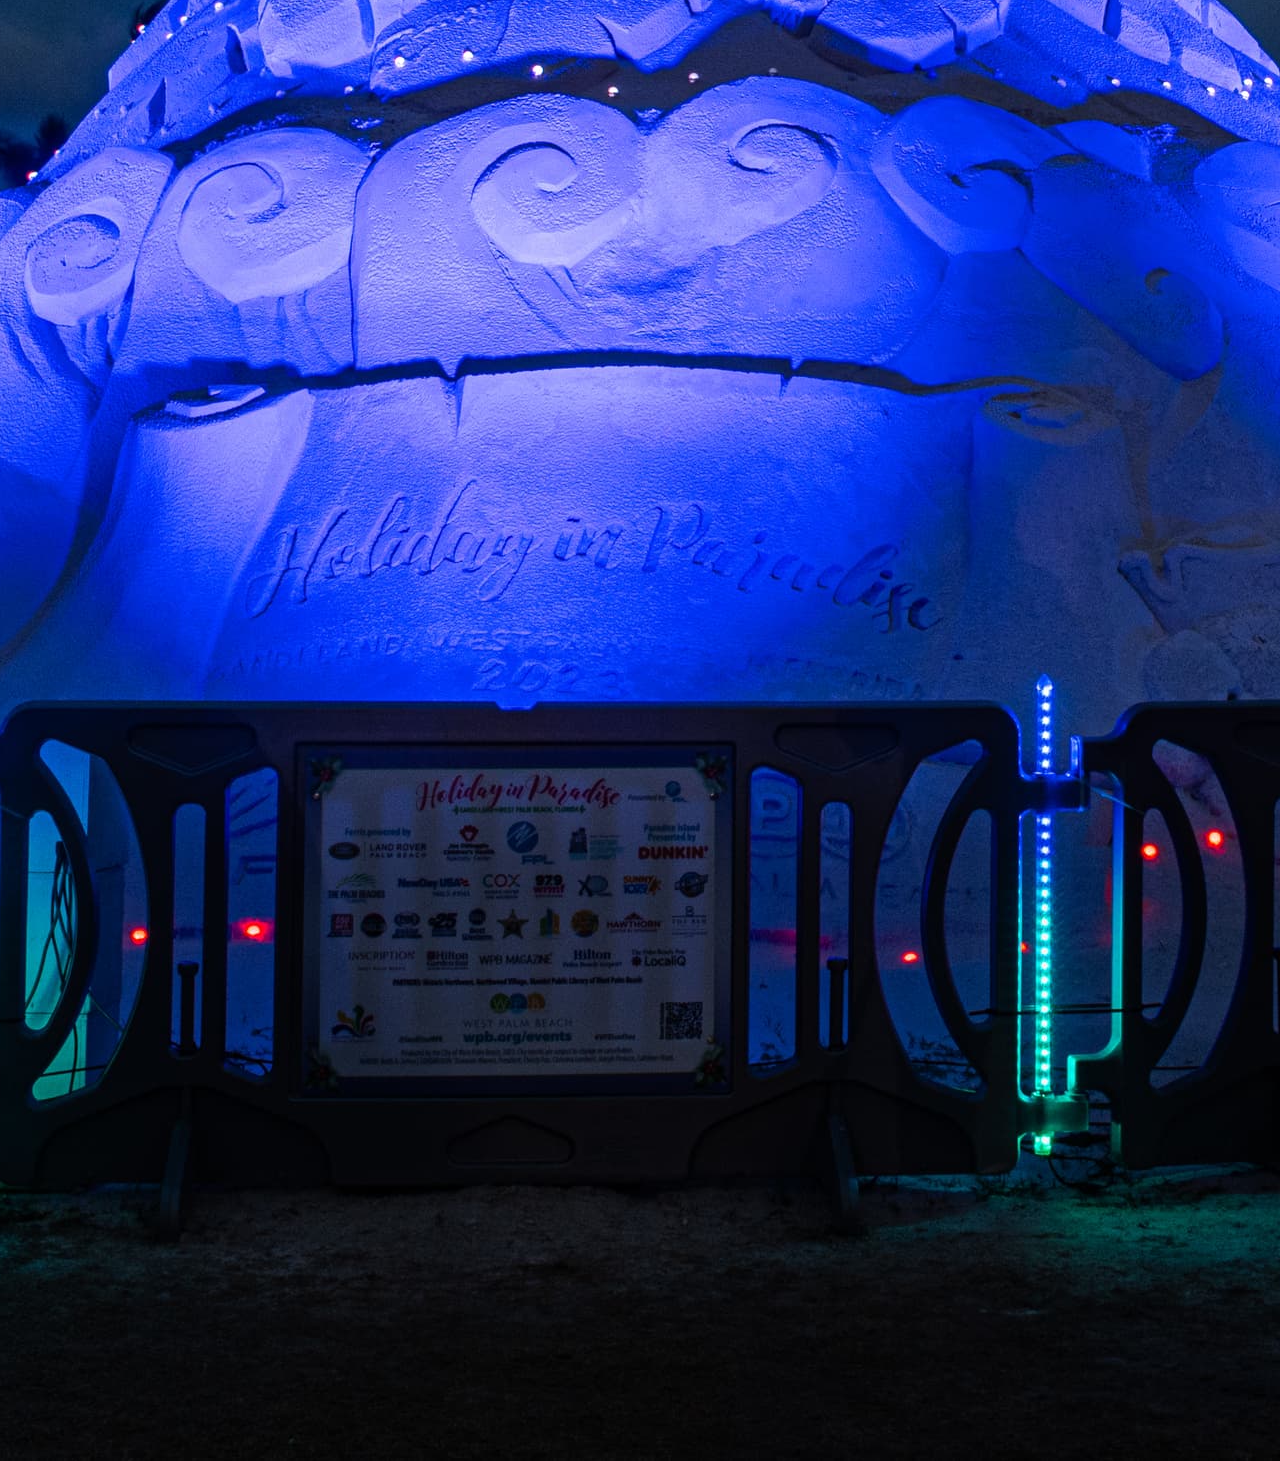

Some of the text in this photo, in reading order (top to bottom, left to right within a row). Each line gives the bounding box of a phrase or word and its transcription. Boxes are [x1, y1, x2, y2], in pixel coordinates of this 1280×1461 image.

[245, 479, 942, 634] Holiday in Paradise
[415, 774, 621, 810] Holiday in Paradise
[369, 842, 394, 851] LAND
[396, 842, 427, 851] ROVER
[638, 846, 709, 860] DUNKIN'
[483, 874, 521, 888] COX
[479, 953, 553, 966] WPB MAGAZINE
[573, 948, 612, 960] Hilton
[644, 955, 687, 967] LocaliQ
[463, 1018, 573, 1028] WEST PALM BEACH
[462, 1031, 573, 1045] wpb.org/events
